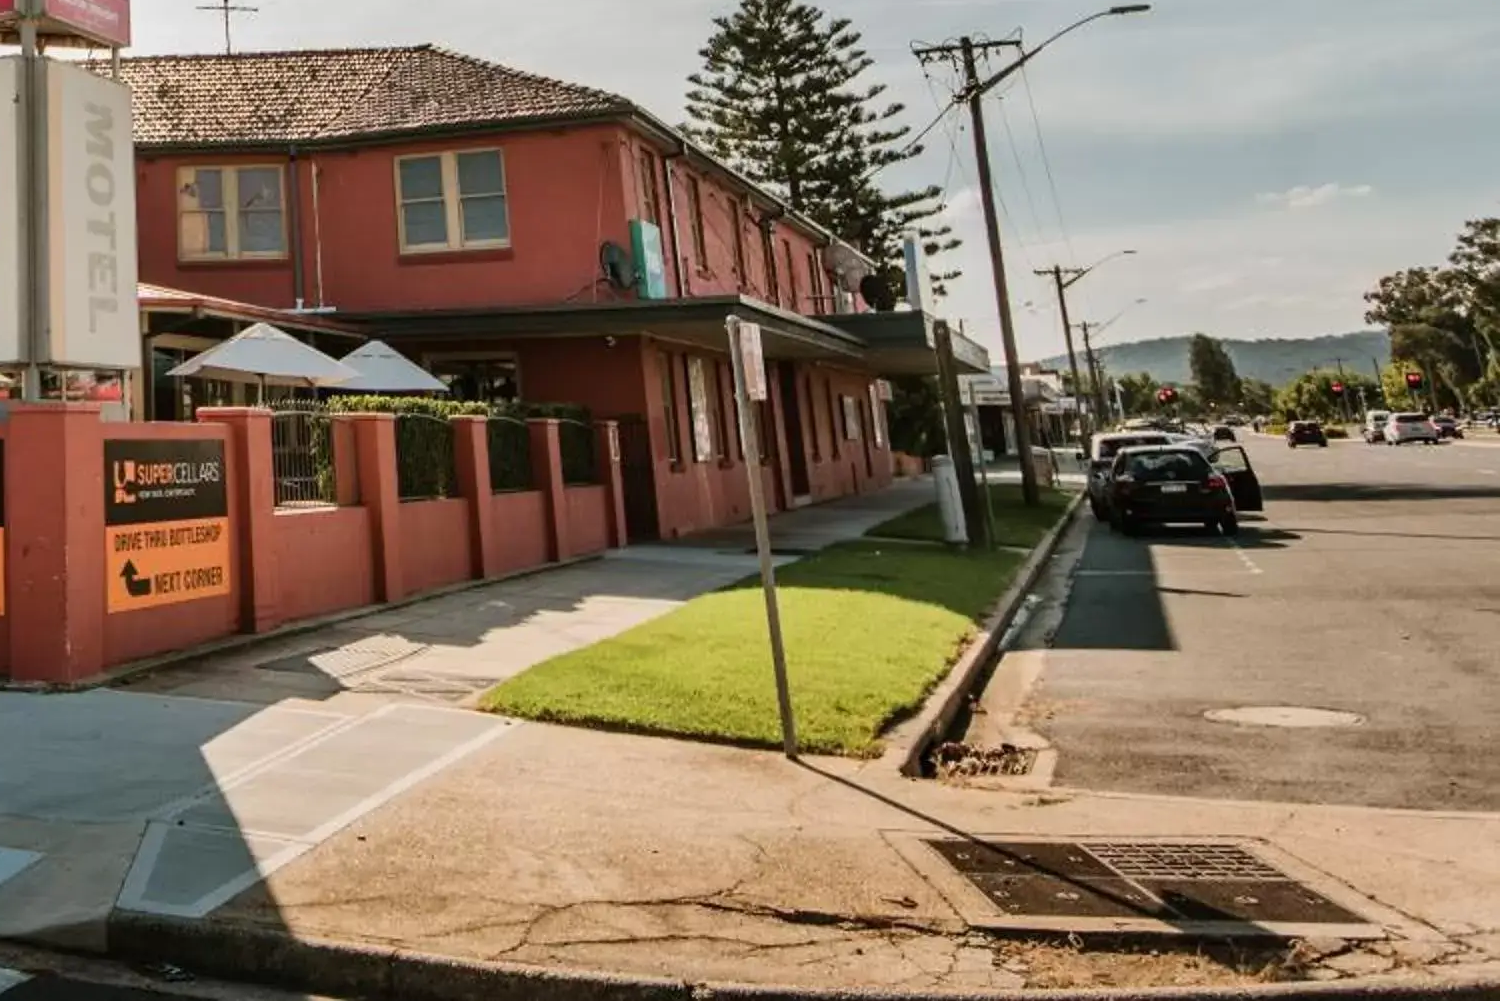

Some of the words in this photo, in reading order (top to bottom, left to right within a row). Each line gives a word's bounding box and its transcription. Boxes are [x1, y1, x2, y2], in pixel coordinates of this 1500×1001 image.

[84, 102, 118, 334] MOTEL
[137, 461, 219, 485] SUPERCELLARS
[115, 530, 142, 552] DRIVE
[144, 530, 168, 549] THRU
[169, 523, 222, 547] BOTTLESHOP
[155, 571, 181, 594] NEXT
[183, 566, 222, 590] CORNER
